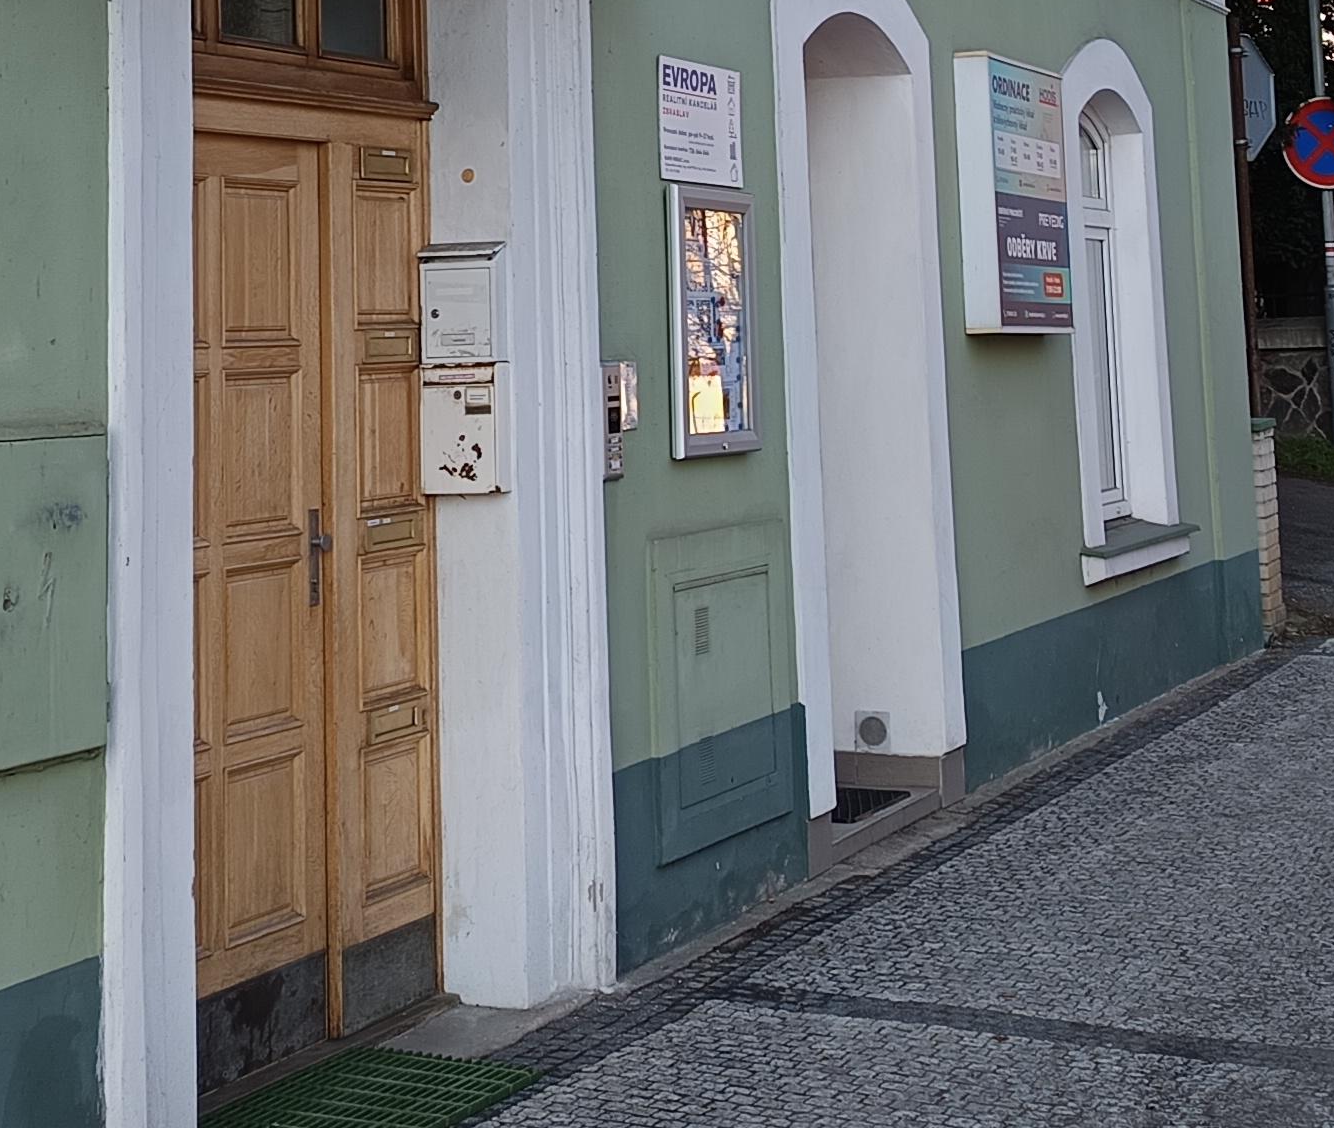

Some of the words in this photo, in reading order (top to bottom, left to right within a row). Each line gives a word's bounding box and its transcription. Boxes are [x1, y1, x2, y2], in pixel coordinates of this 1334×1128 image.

[662, 63, 717, 96] EVROPA
[992, 75, 1031, 103] ORDINACE
[1006, 234, 1036, 259] ODBĚRY
[1036, 240, 1057, 261] KRVE
